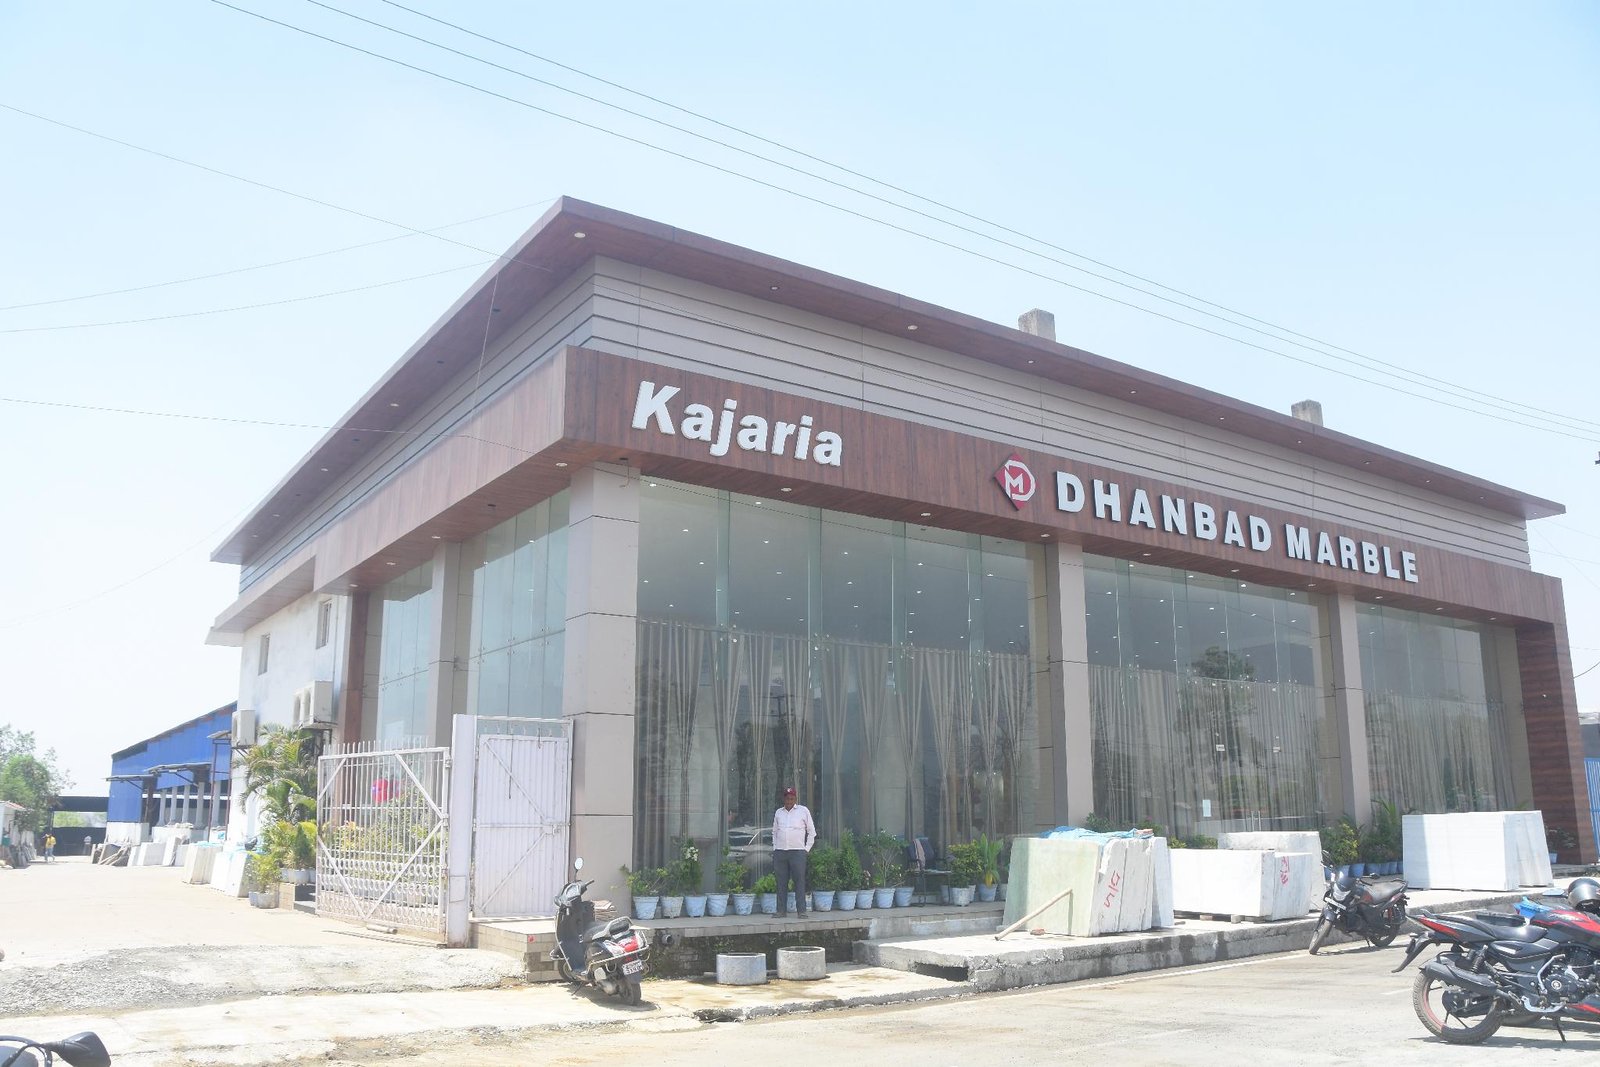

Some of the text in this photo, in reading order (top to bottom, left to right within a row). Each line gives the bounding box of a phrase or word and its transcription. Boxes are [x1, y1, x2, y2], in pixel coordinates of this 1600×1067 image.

[632, 380, 842, 467] Kajaria
[1055, 471, 1419, 583] DHANBAD MARBLE
